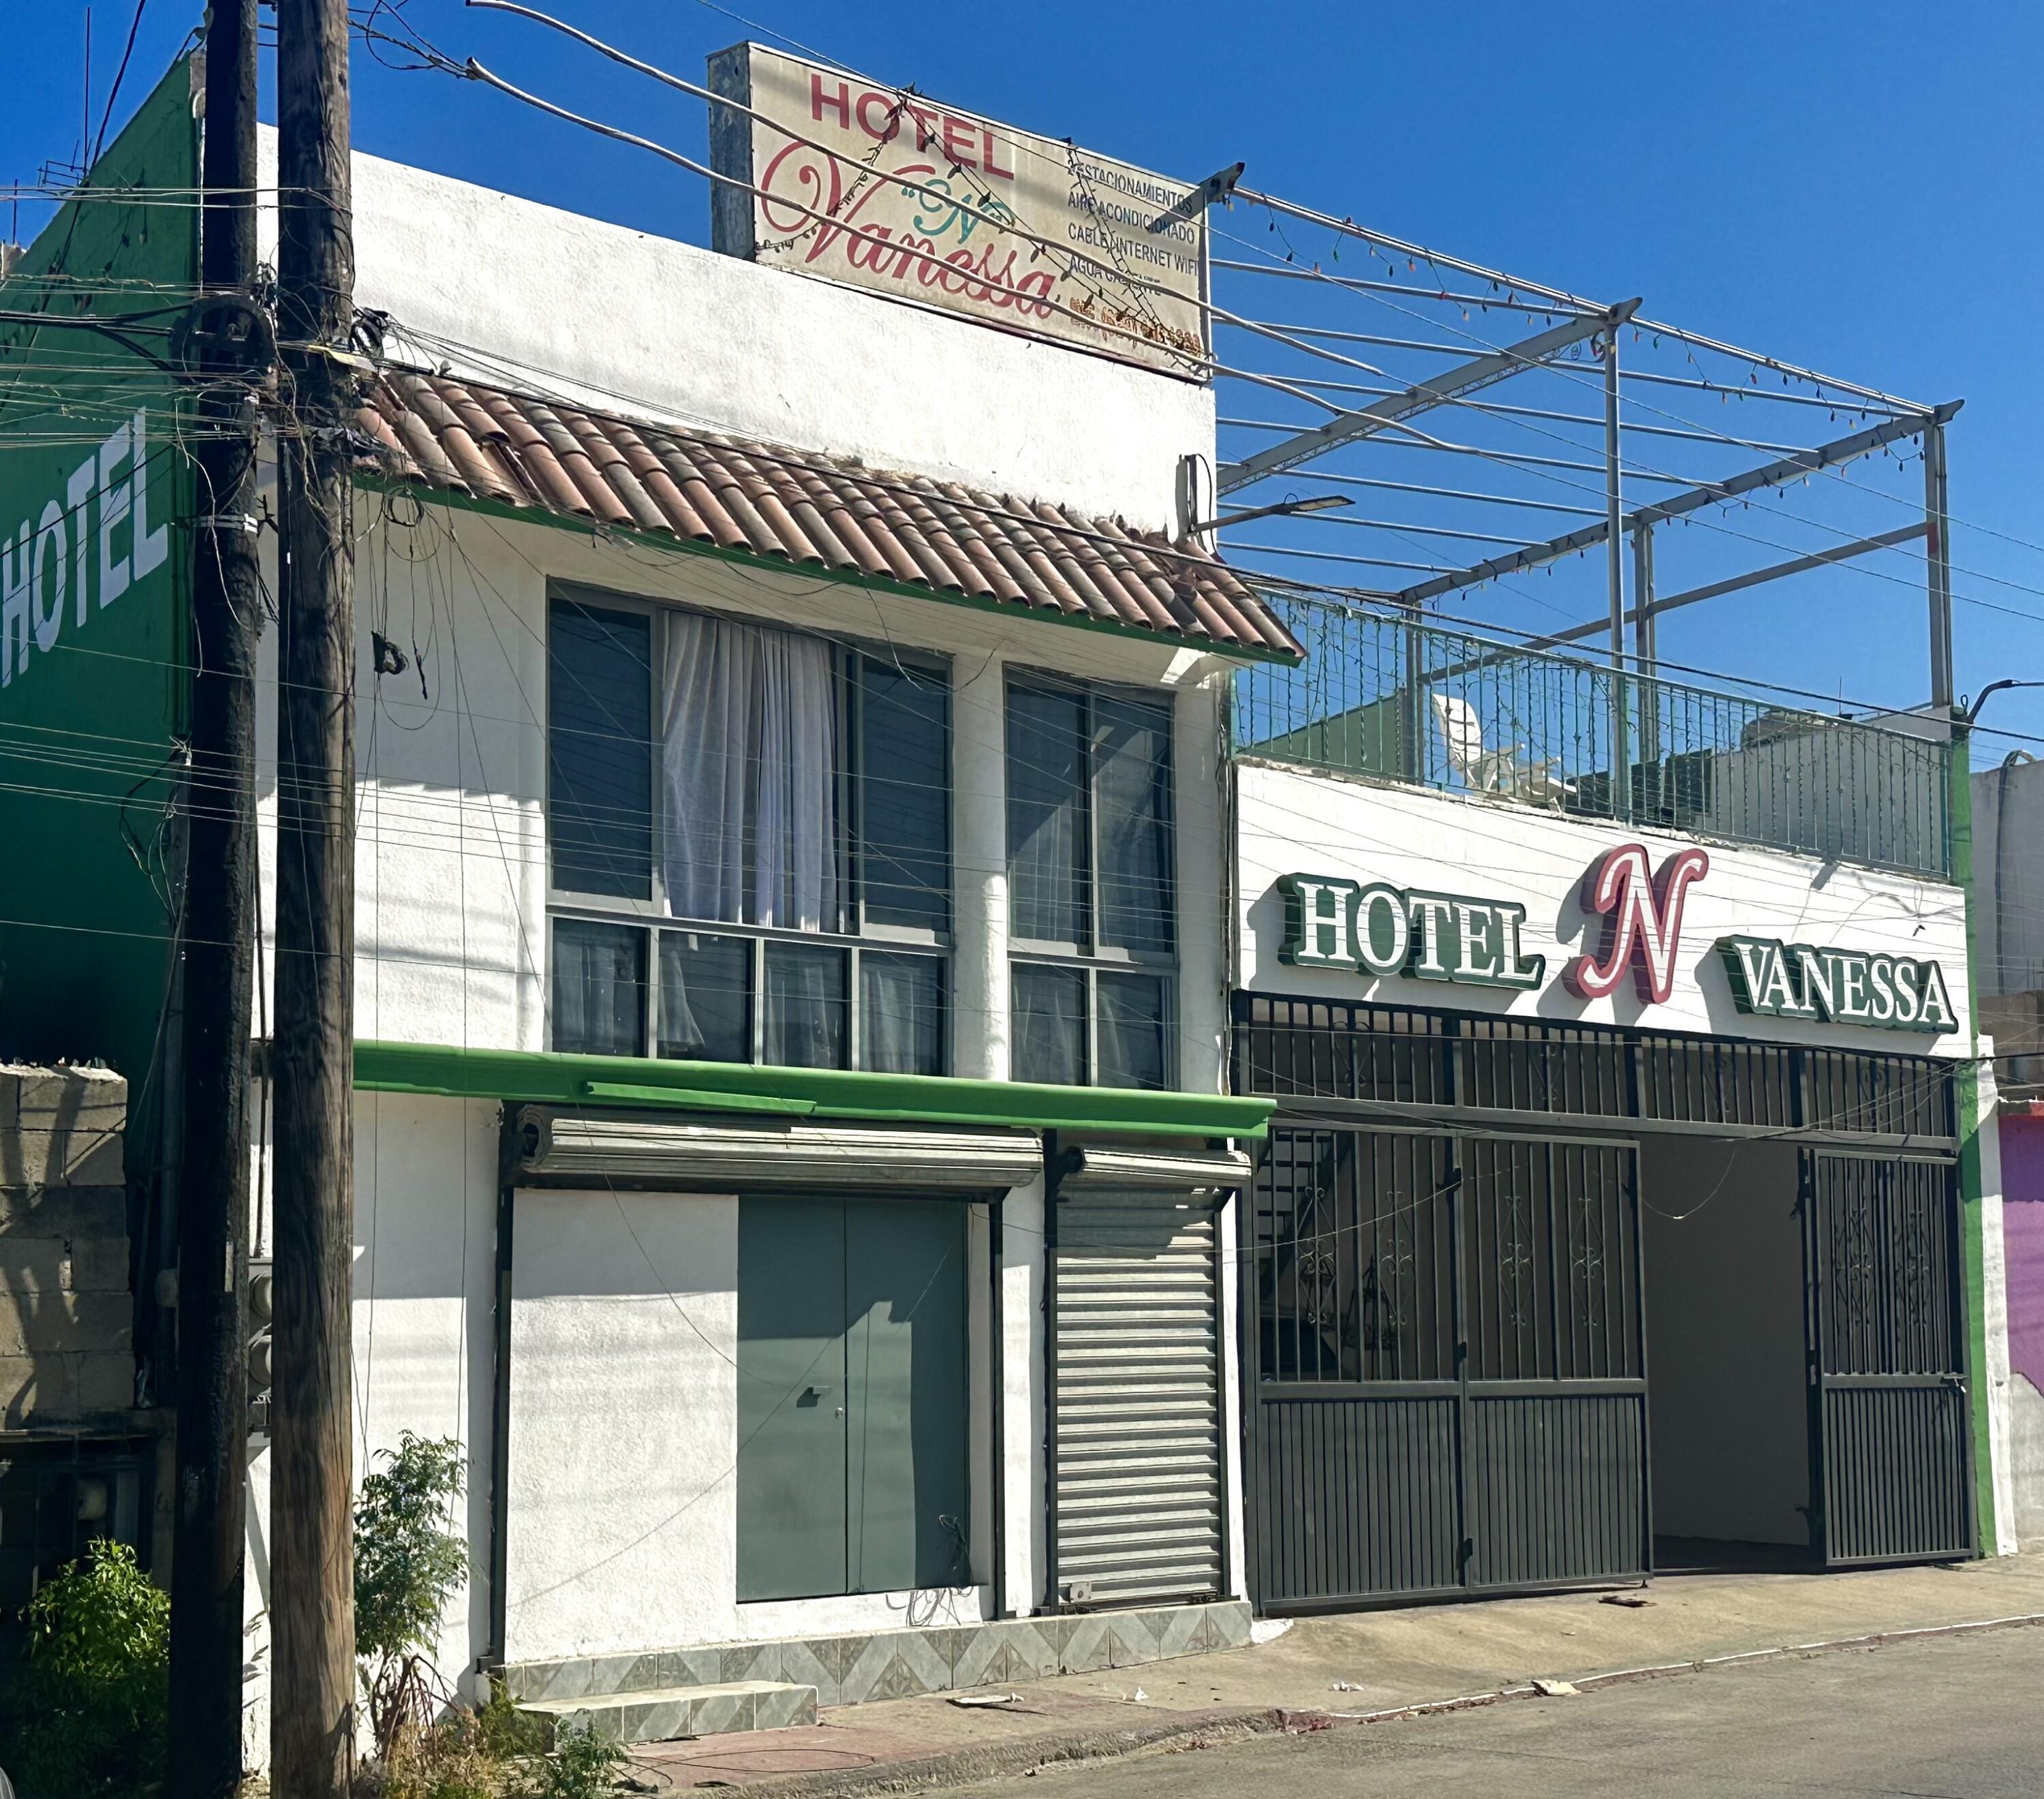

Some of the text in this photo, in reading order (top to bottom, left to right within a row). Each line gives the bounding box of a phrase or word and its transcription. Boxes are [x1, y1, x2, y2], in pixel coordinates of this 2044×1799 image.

[811, 74, 1015, 181] HOTEL
[760, 140, 1057, 320] Vanessa
[1116, 236, 1172, 270] INTERNET
[1, 405, 168, 688] HOTEL
[1296, 843, 1955, 1026] HOTEL N VANESSA
